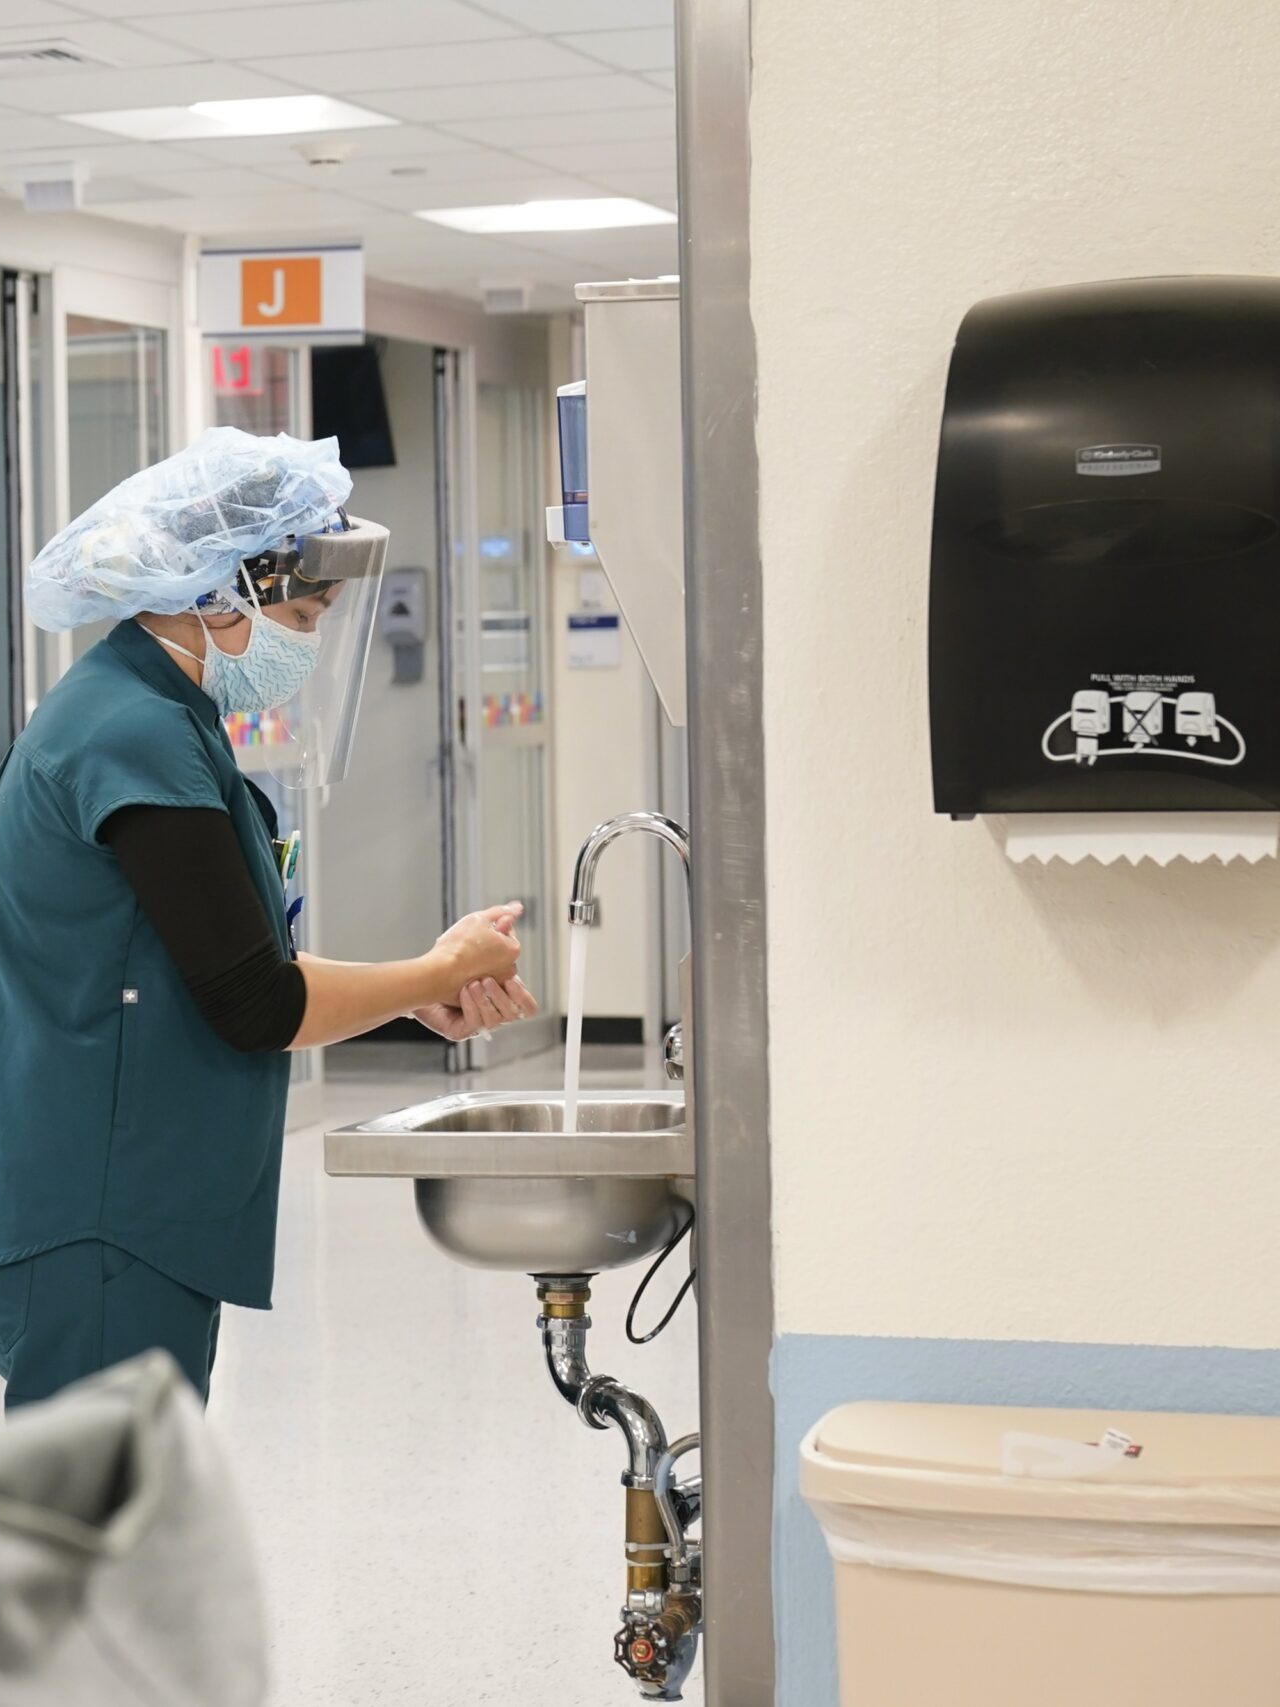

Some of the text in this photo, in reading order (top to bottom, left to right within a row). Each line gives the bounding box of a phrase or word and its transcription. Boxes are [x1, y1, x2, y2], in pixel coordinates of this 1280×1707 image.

[257, 268, 285, 318] J
[1090, 673, 1195, 683] PULL WITH BOTH HANDS
